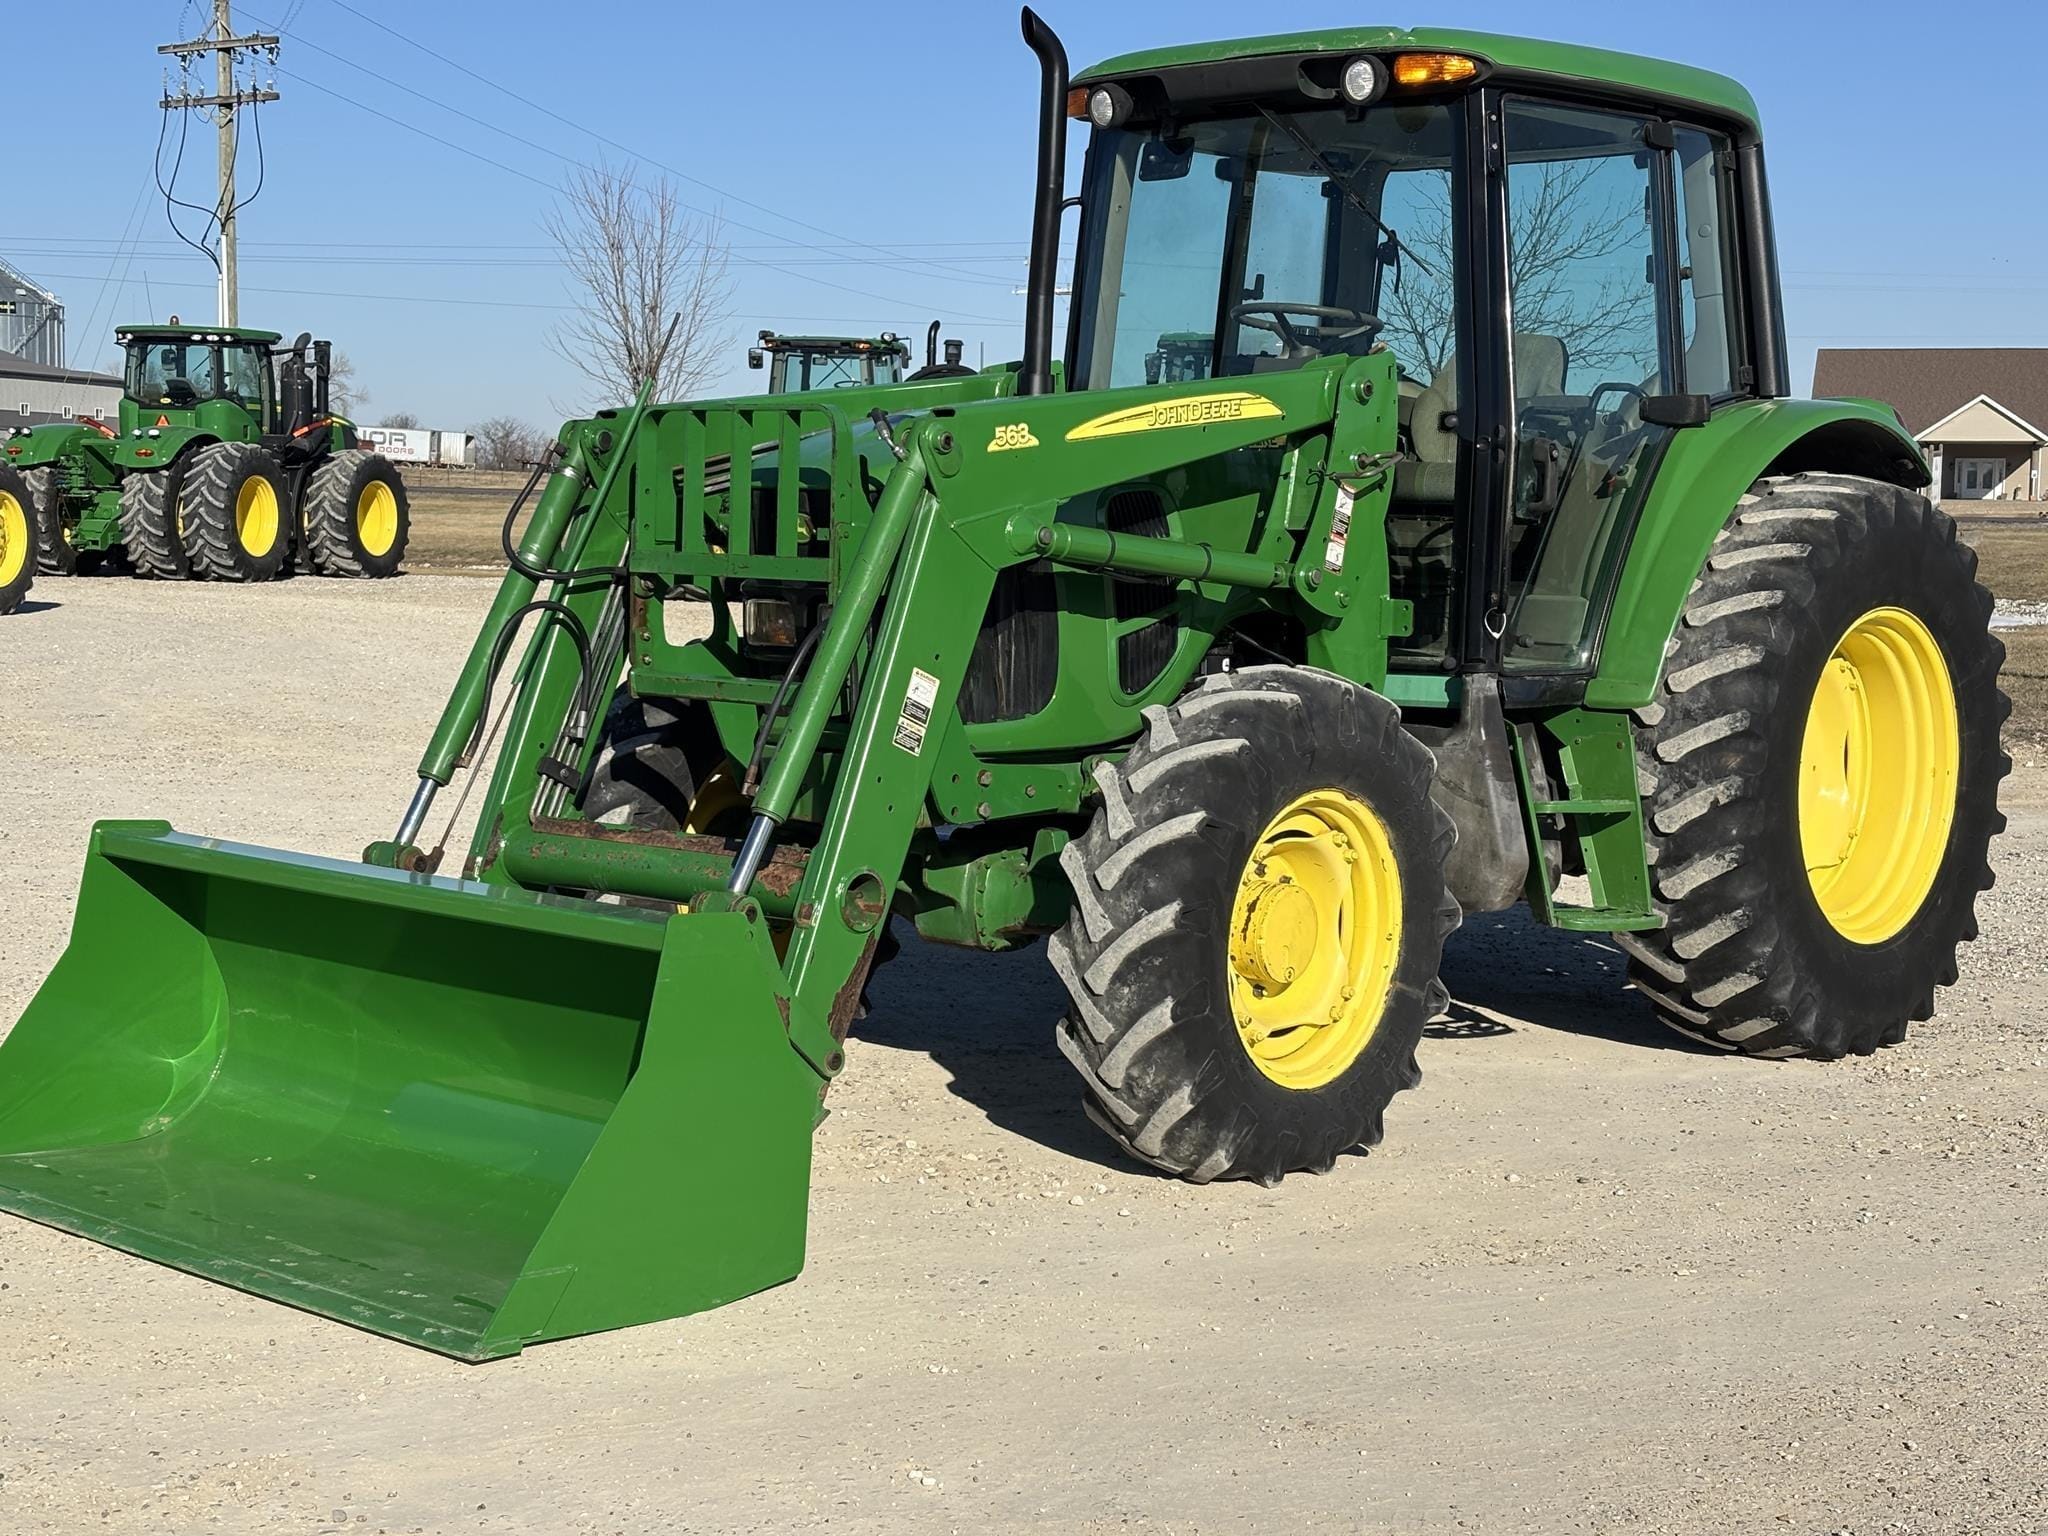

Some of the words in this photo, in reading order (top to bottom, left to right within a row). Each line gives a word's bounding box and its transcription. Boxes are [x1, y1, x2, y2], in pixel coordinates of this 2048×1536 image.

[1148, 405, 1188, 426] JOHN
[1189, 400, 1242, 421] DEERE
[994, 423, 1030, 446] 563
[378, 446, 415, 455] DOORS
